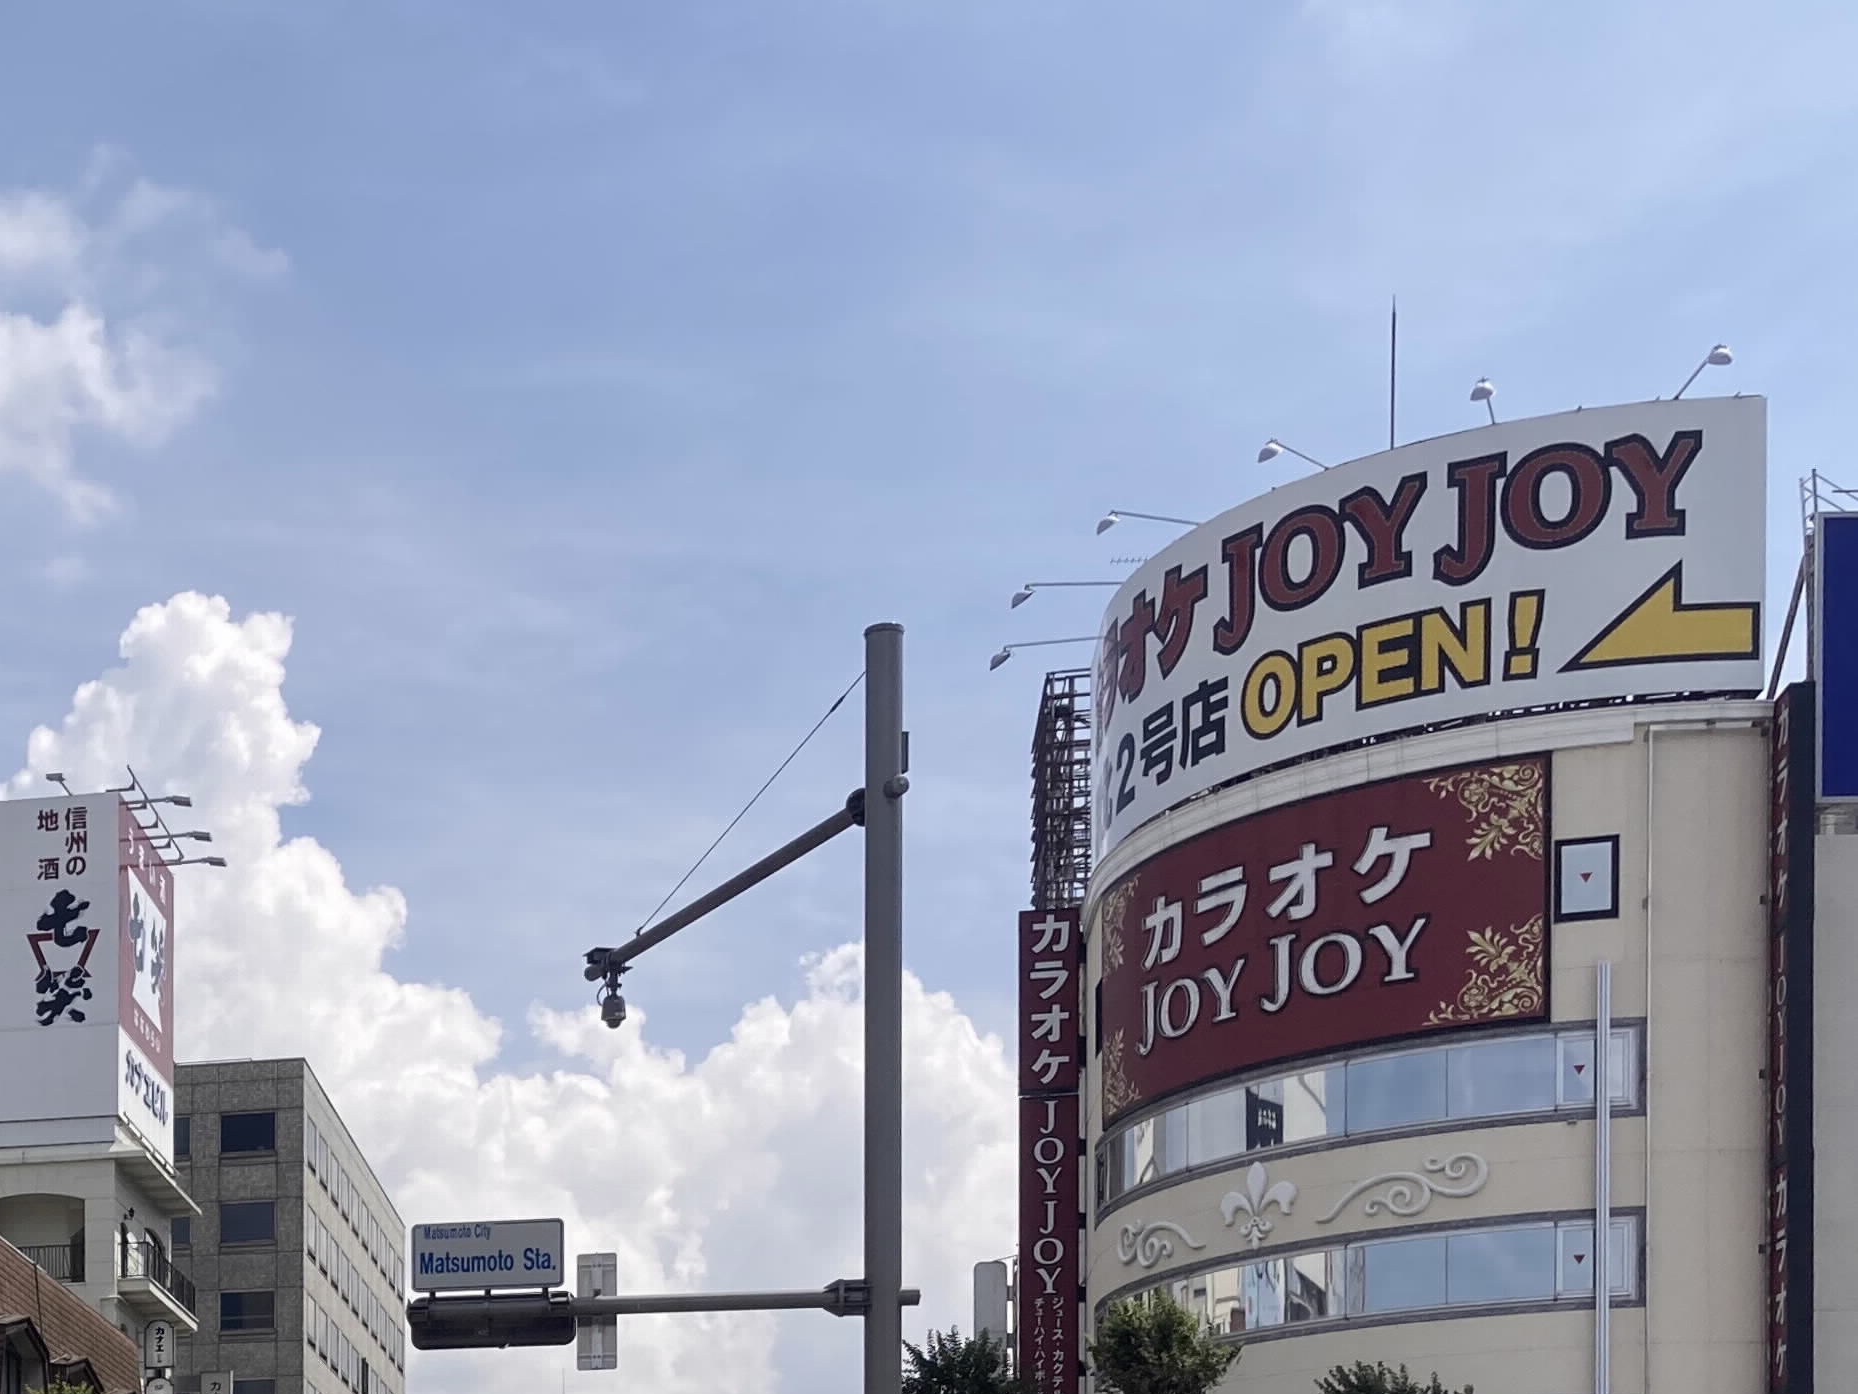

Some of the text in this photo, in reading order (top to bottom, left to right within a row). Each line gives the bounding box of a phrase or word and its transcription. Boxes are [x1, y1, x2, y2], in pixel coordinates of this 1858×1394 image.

[1213, 473, 1427, 656] JOY
[1432, 430, 1703, 586] JOY
[1240, 589, 1546, 742] OPEN!
[36, 809, 60, 881] 地酒
[64, 806, 88, 876] 信州の
[1776, 704, 1790, 910] カラオケ
[1143, 825, 1432, 969] カラオケ
[1137, 917, 1430, 1057] JOY JOY
[1029, 913, 1071, 1296] カラオケ JOY JOY
[419, 1247, 557, 1275] Matsumoto Sta.
[423, 1223, 491, 1241] Matsumoto City
[1774, 1176, 1789, 1380] カラオケ
